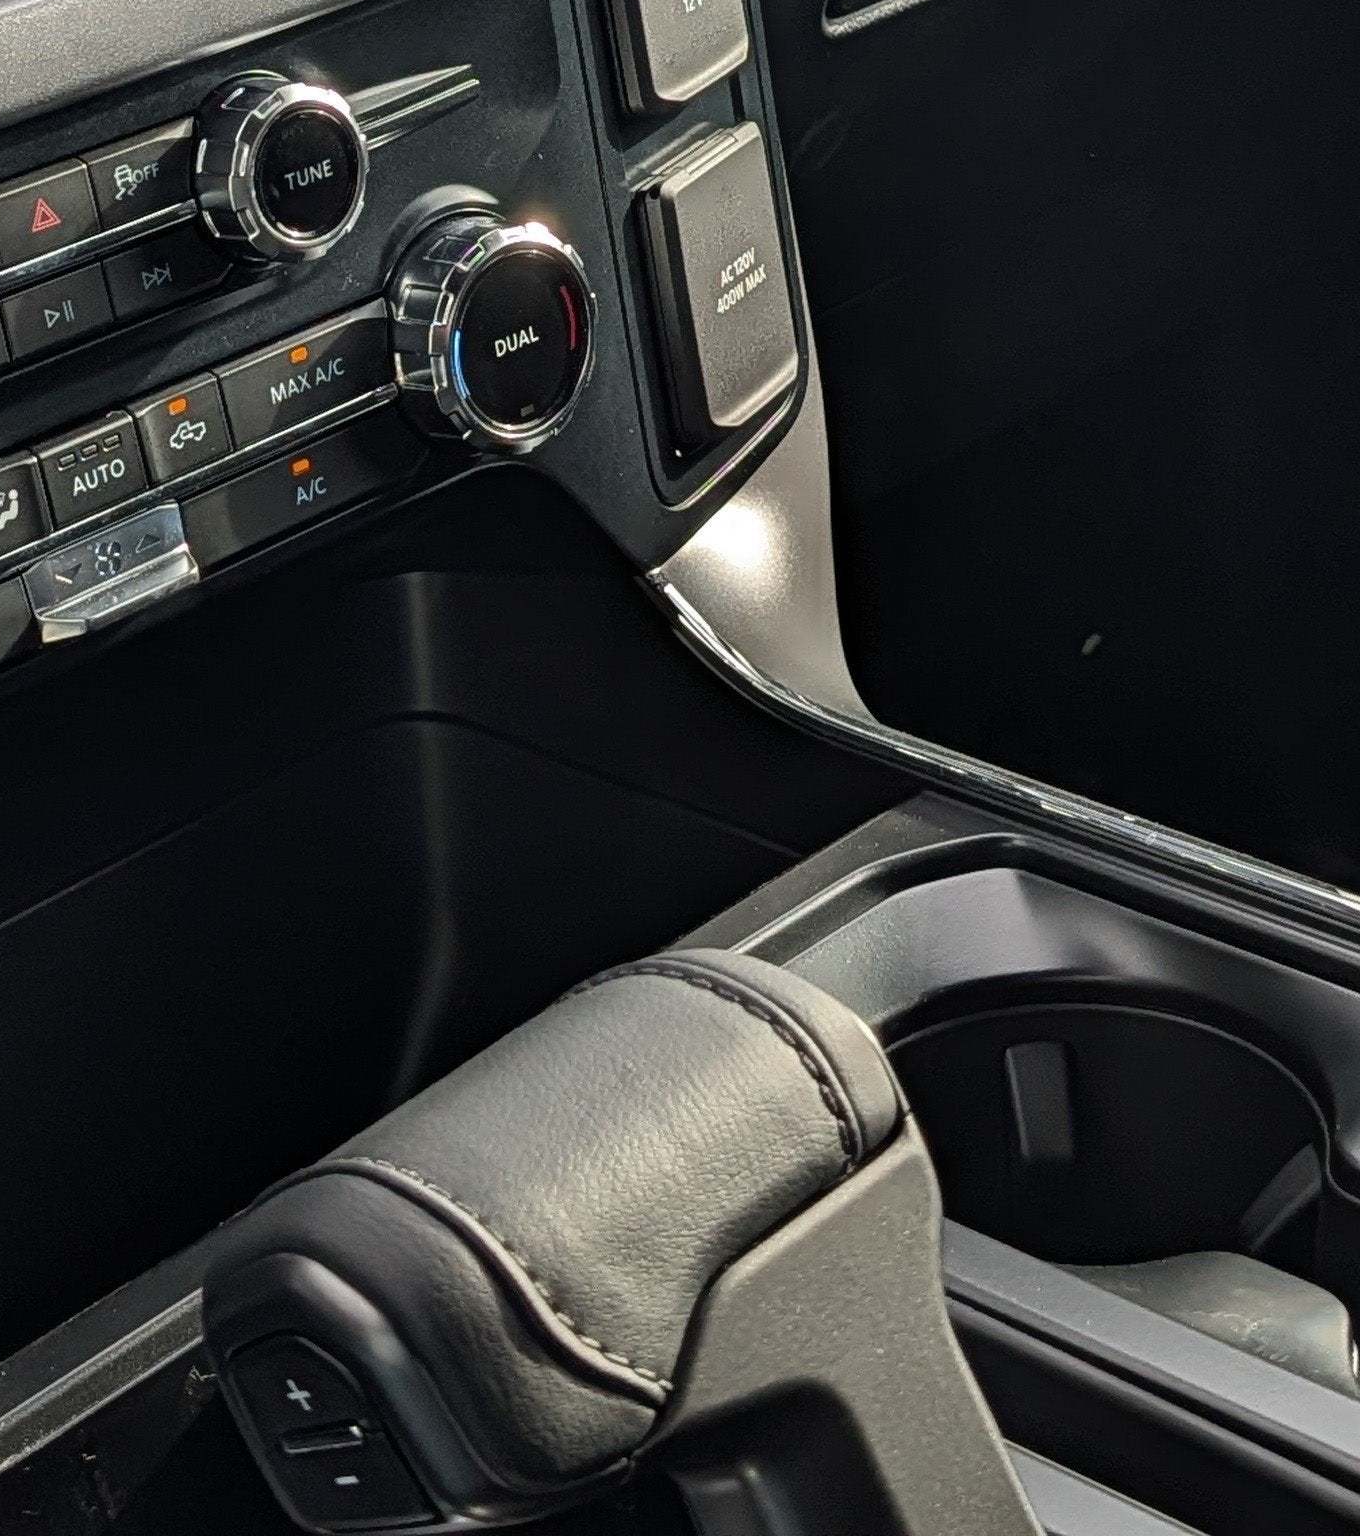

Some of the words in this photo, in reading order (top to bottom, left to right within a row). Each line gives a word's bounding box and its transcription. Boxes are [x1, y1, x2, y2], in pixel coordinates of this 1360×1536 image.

[133, 163, 159, 185] OFF
[285, 159, 334, 190] TUNE
[746, 264, 766, 292] MAX
[495, 326, 539, 357] DUAL
[270, 374, 310, 405] MAX
[315, 358, 345, 386] A/C
[72, 459, 126, 497] AUTO
[295, 476, 327, 505] A/C
